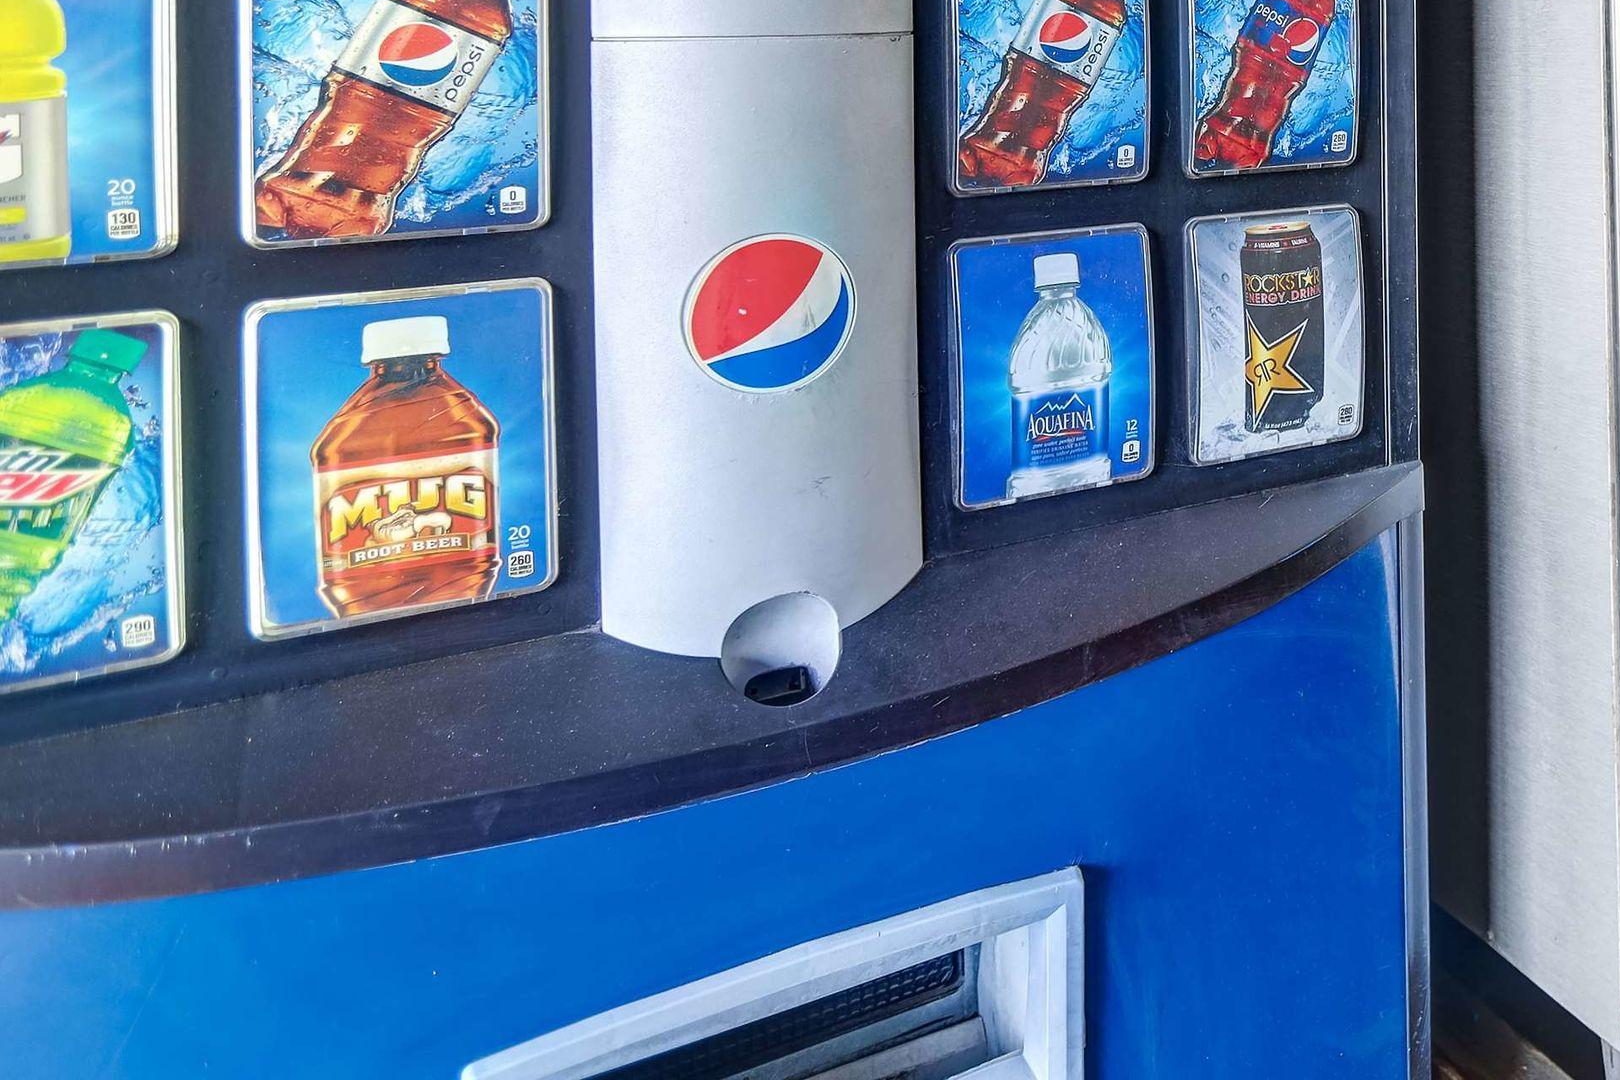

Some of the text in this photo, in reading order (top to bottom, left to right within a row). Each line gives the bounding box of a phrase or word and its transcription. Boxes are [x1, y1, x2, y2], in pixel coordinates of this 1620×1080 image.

[1253, 3, 1290, 28] pepsi
[1082, 28, 1110, 77] pepsi
[444, 43, 485, 102] pepsi
[1123, 148, 1129, 158] 0
[107, 178, 136, 197] 20
[509, 190, 517, 201] 0
[111, 211, 136, 225] 130
[1025, 404, 1095, 442] AQUAFINA
[1126, 419, 1138, 431] 12
[1128, 443, 1135, 452] 0
[327, 474, 487, 544] MUG
[508, 524, 531, 541] 20
[354, 545, 406, 563] ROOT
[412, 536, 463, 553] BEER
[510, 553, 531, 567] 260
[126, 619, 151, 634] 290
